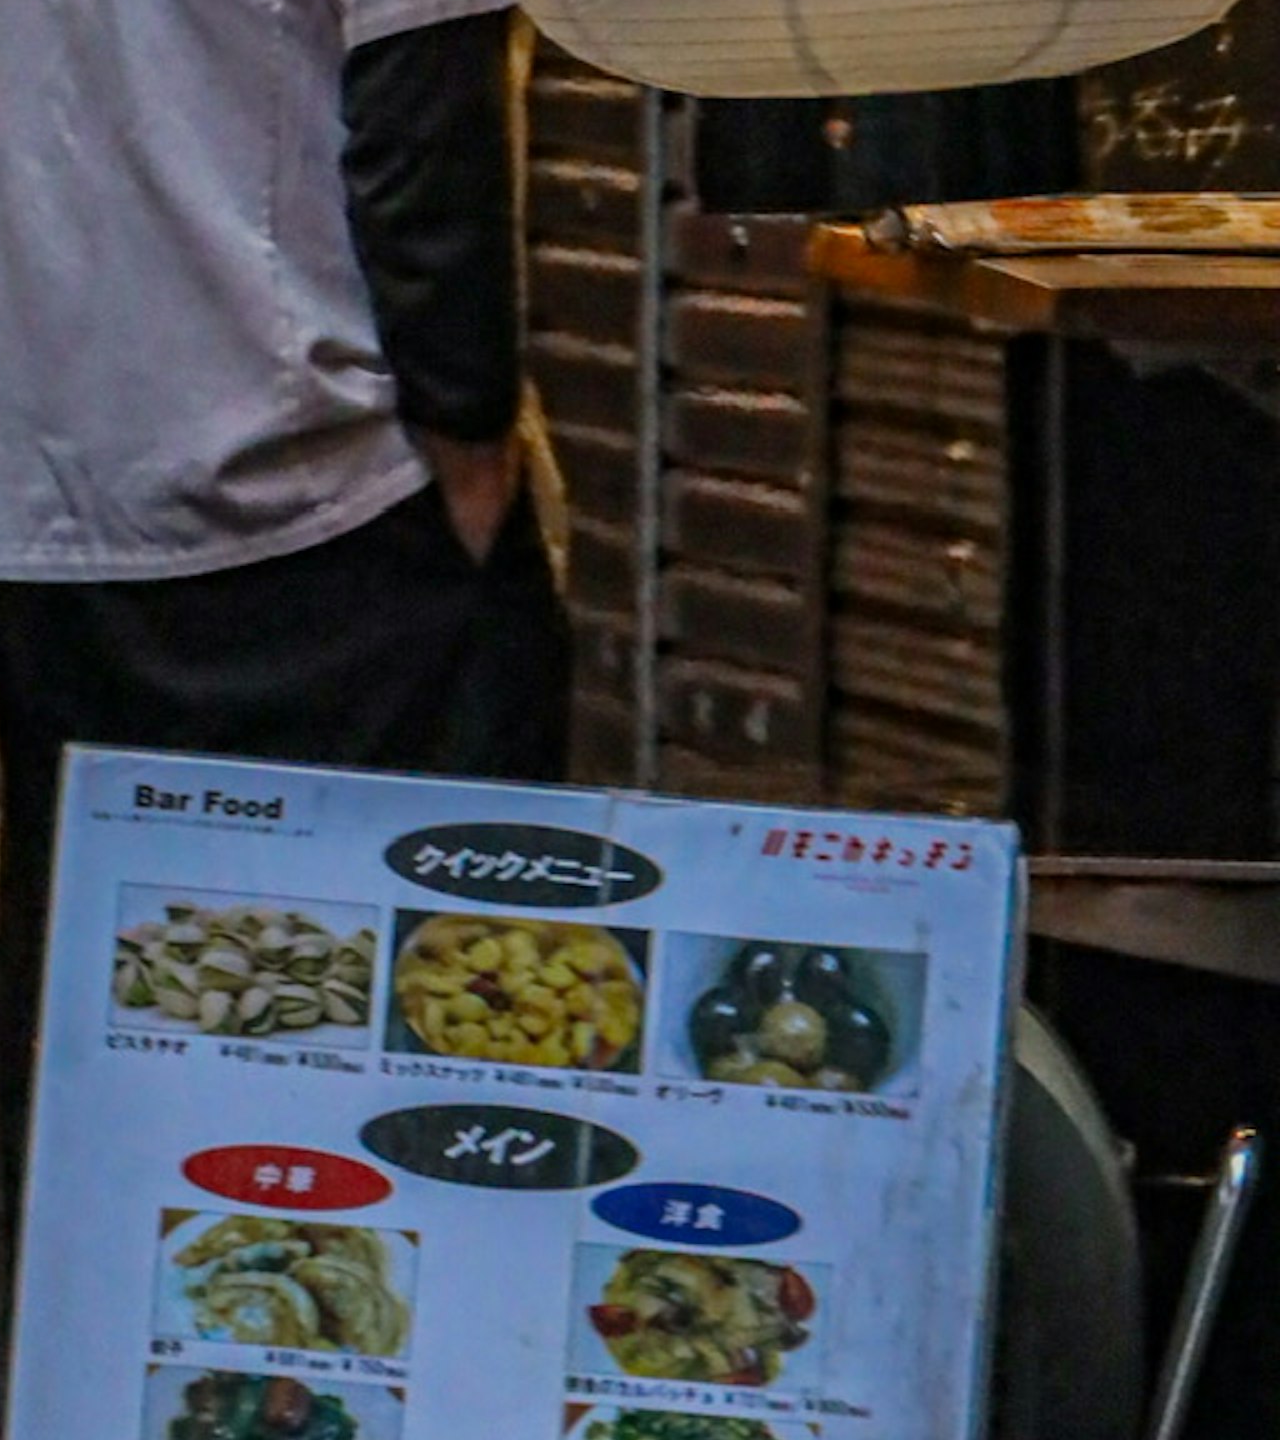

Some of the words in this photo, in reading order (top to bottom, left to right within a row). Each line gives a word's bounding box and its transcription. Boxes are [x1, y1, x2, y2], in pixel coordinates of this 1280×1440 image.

[133, 784, 193, 811] Bar
[203, 790, 284, 820] Food
[413, 843, 635, 888] クイックメニュー
[444, 1124, 555, 1167] メイン
[659, 1199, 727, 1232] 洋食
